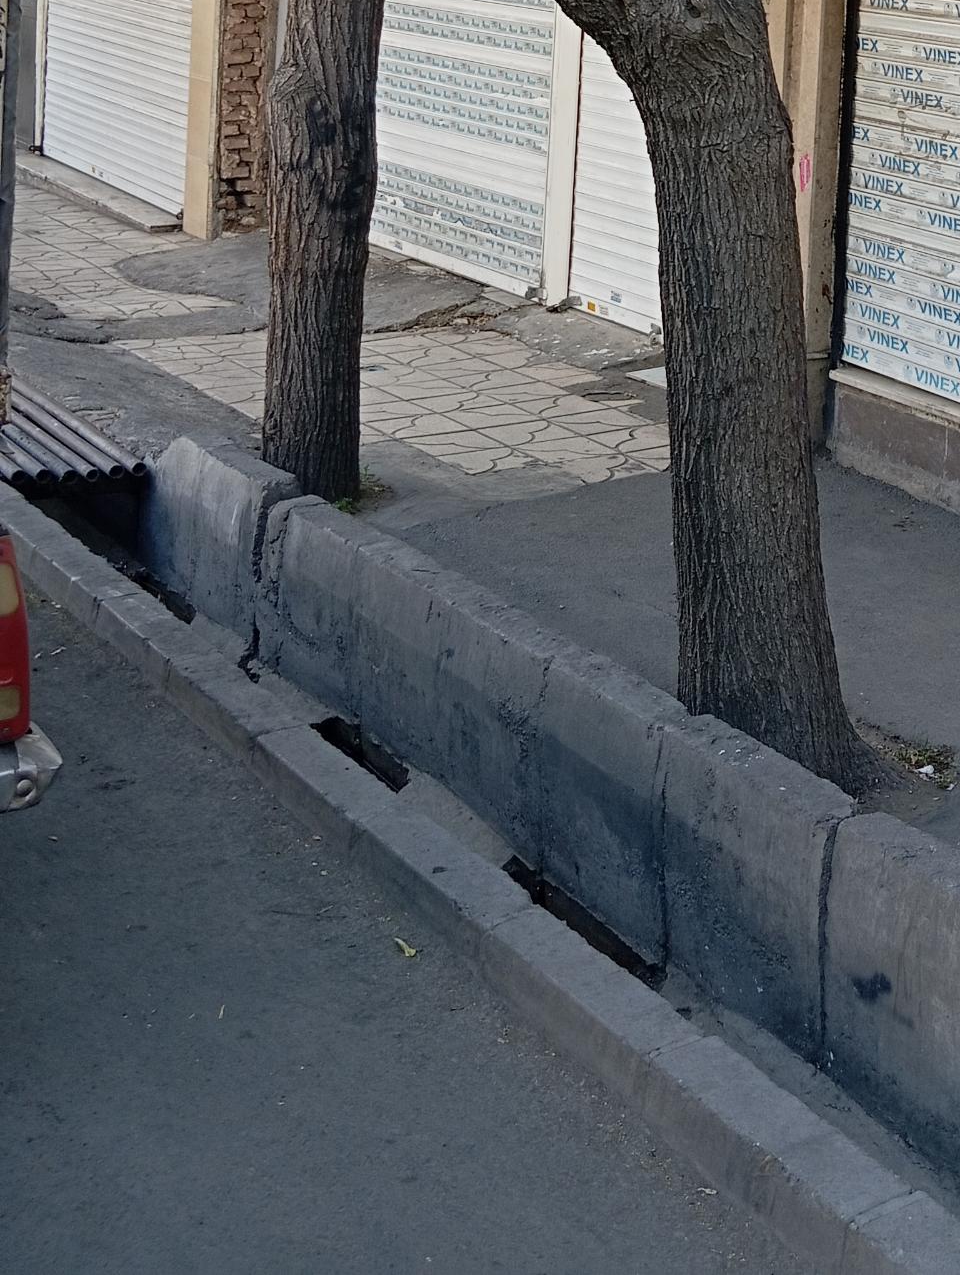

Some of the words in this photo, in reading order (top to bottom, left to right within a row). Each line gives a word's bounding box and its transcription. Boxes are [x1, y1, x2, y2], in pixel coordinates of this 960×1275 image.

[881, 63, 922, 83] VINEX
[900, 88, 942, 109] VINEX
[914, 137, 957, 160] VINEX
[879, 154, 920, 176] VINEX
[862, 173, 902, 195] VINEX
[863, 239, 904, 264] VINEX
[855, 259, 895, 284] VINEX
[859, 303, 899, 329] VINEX
[867, 328, 908, 355] VINEX
